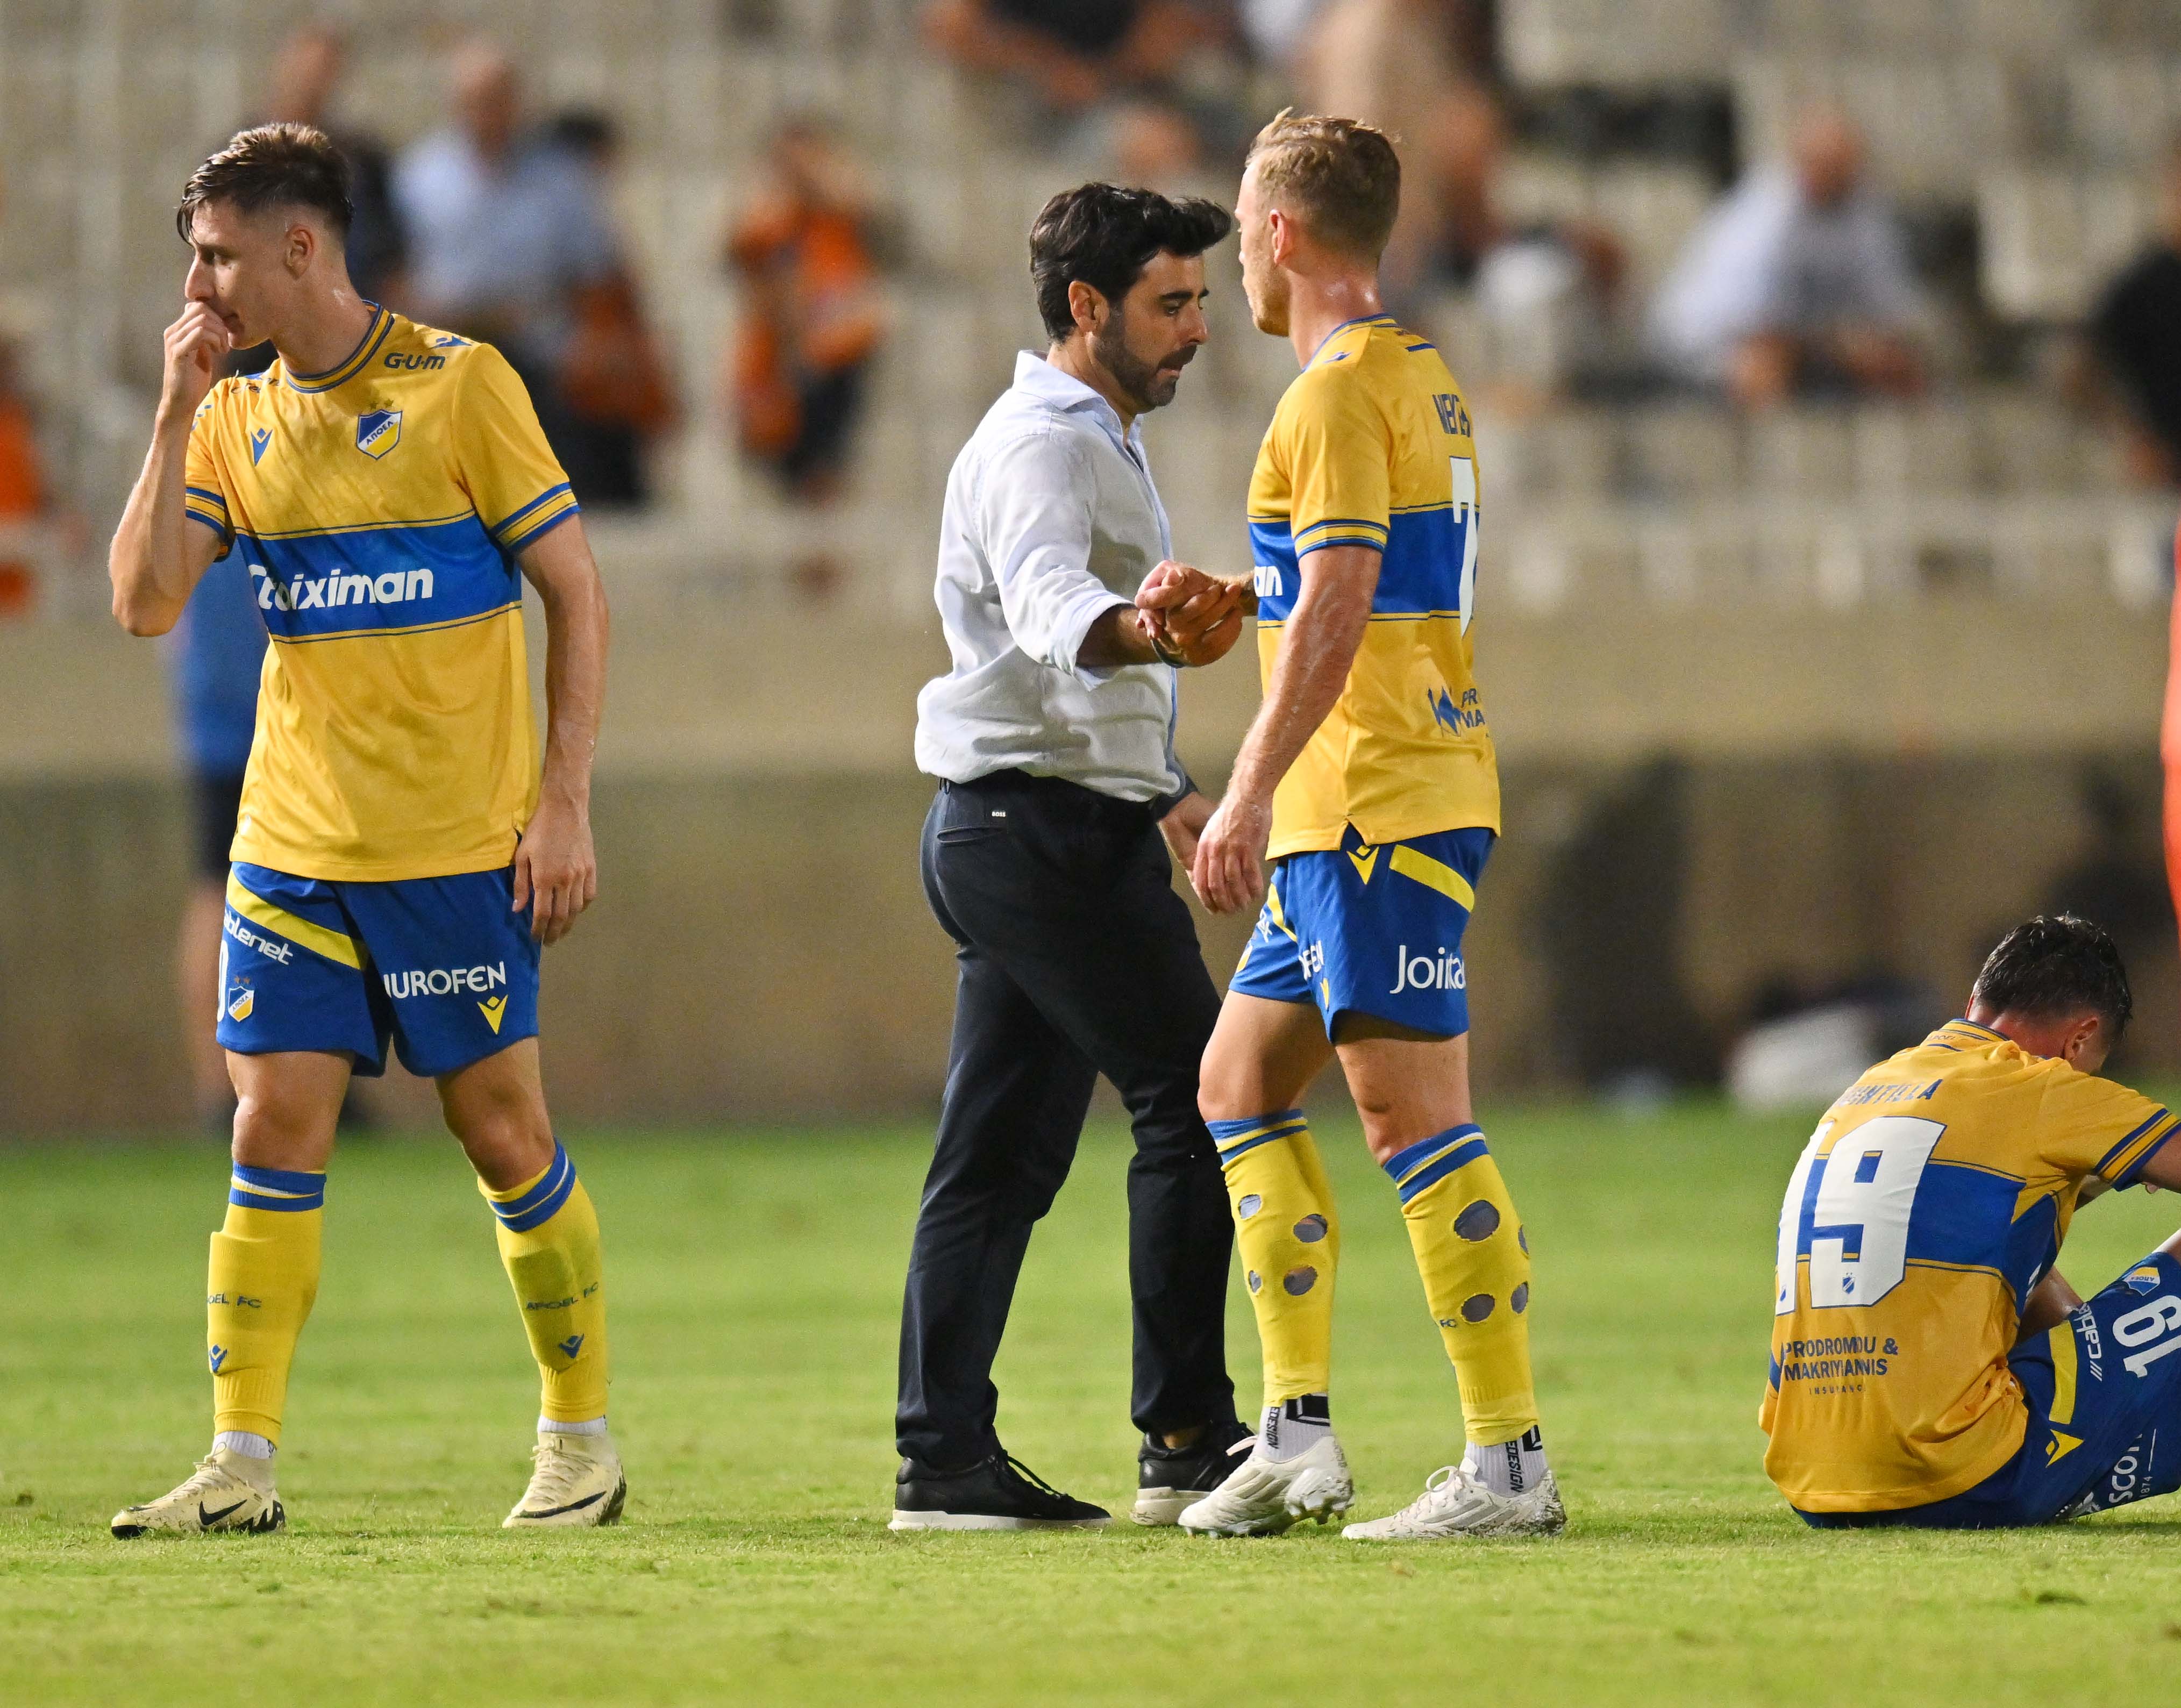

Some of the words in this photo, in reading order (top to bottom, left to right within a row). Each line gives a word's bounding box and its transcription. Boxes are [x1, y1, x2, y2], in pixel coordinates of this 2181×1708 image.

[1449, 456, 1478, 638] 7
[1774, 1115, 1948, 1317] 19
[237, 1295, 262, 1308] FC
[2113, 1295, 2181, 1378] 19
[1883, 1338, 1899, 1355] &
